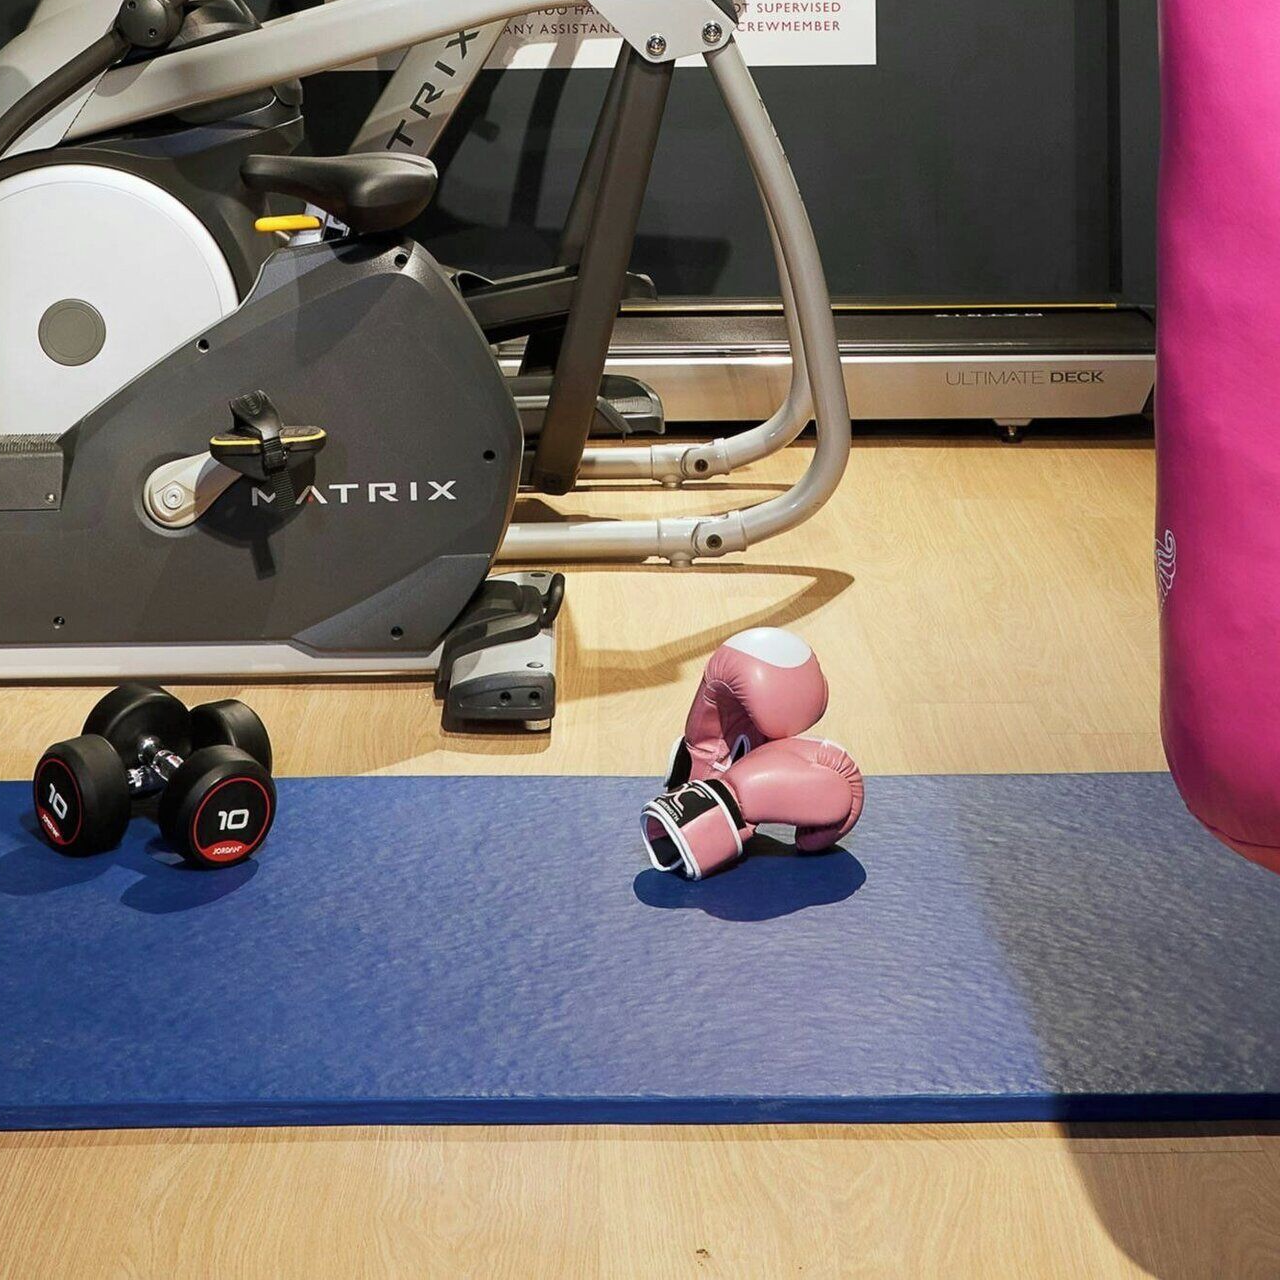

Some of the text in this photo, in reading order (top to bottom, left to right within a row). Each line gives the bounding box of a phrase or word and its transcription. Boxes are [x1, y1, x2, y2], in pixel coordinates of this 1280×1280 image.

[756, 2, 841, 13] SUPERVISED
[503, 24, 534, 35] ANY
[736, 20, 841, 32] CREWMEMBER
[385, 30, 480, 151] TRIX
[946, 371, 1105, 386] ULTIMATE DECK
[251, 480, 457, 507] MATRIX
[48, 783, 68, 820] 10
[218, 807, 250, 831] 10
